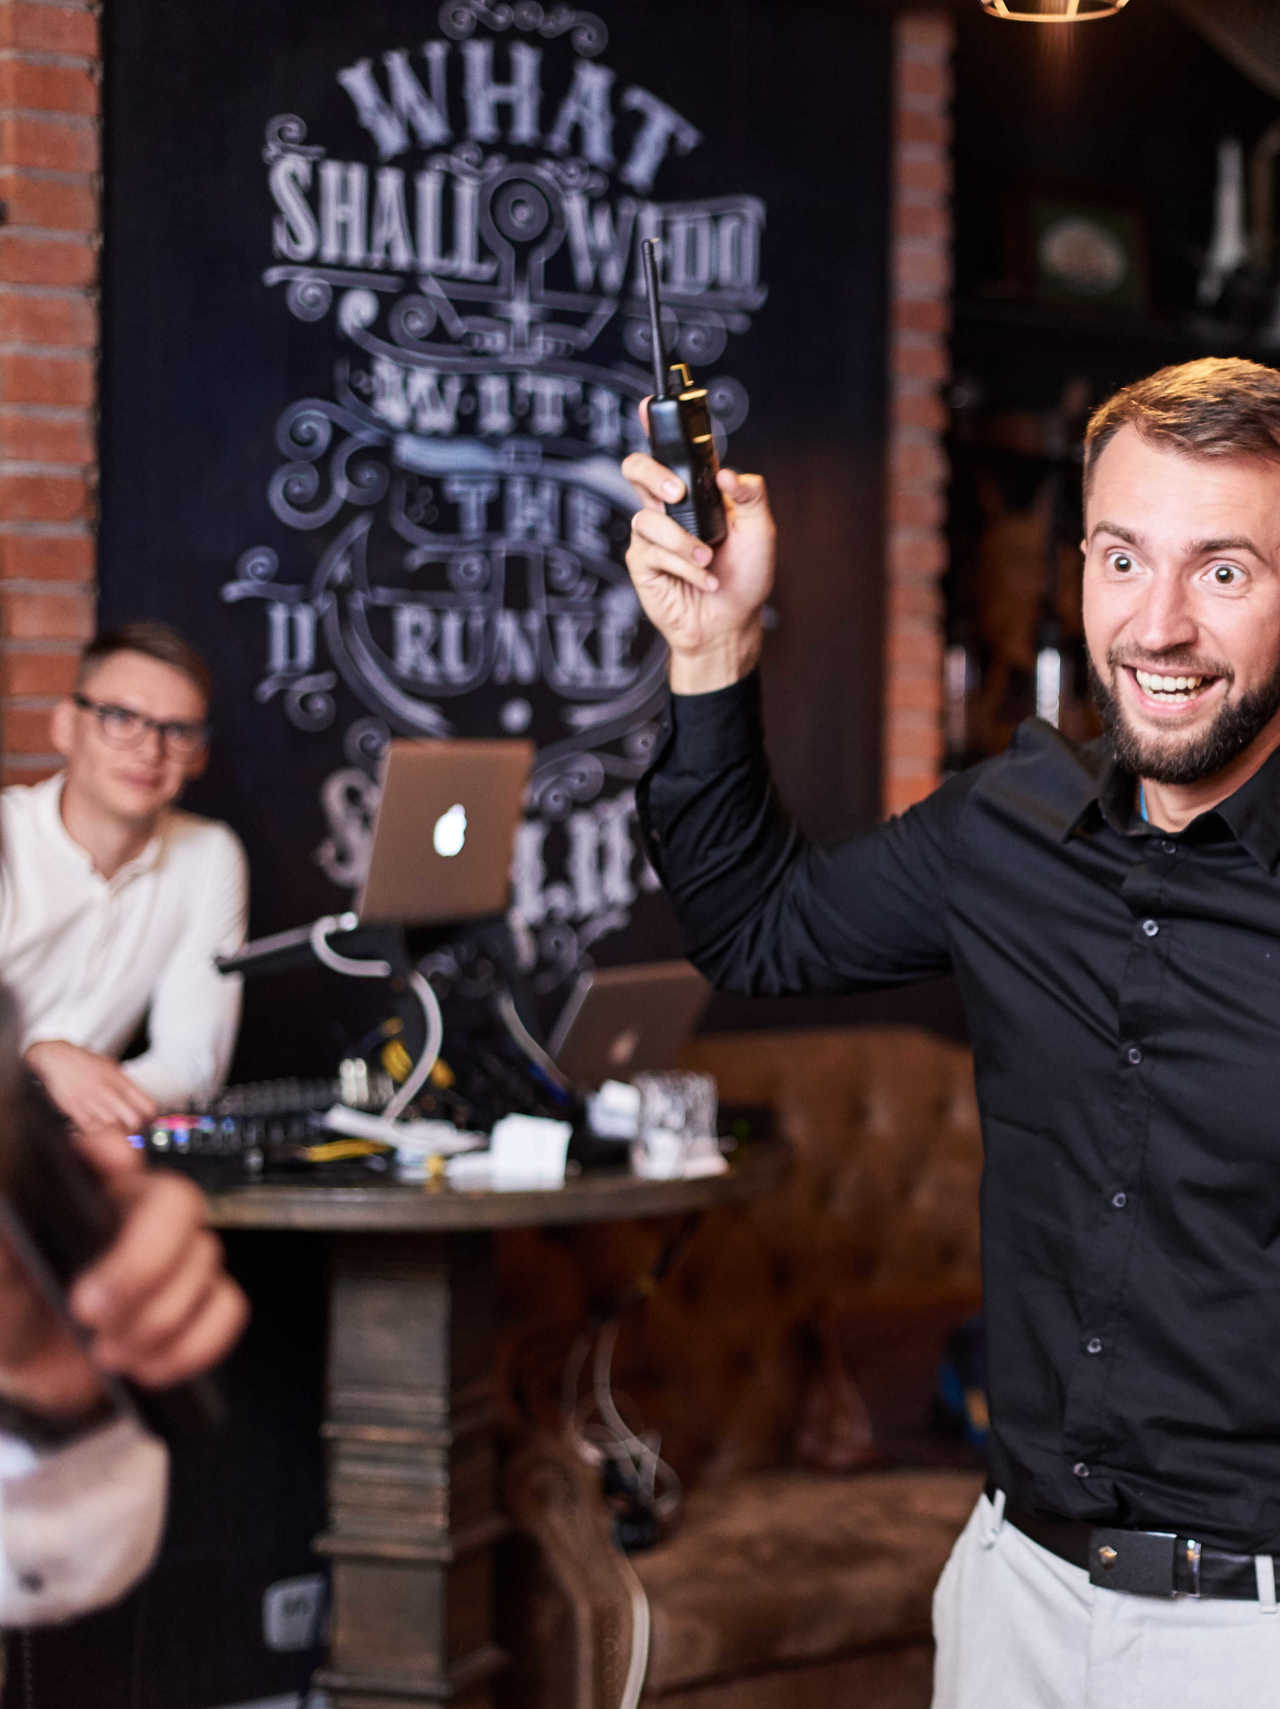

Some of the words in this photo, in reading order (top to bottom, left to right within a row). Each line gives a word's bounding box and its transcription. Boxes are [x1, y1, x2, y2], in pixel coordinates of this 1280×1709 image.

[336, 38, 701, 194] WHAT
[267, 153, 500, 281] SHALL
[444, 474, 612, 556] THE
[266, 598, 648, 690] DRUNKE
